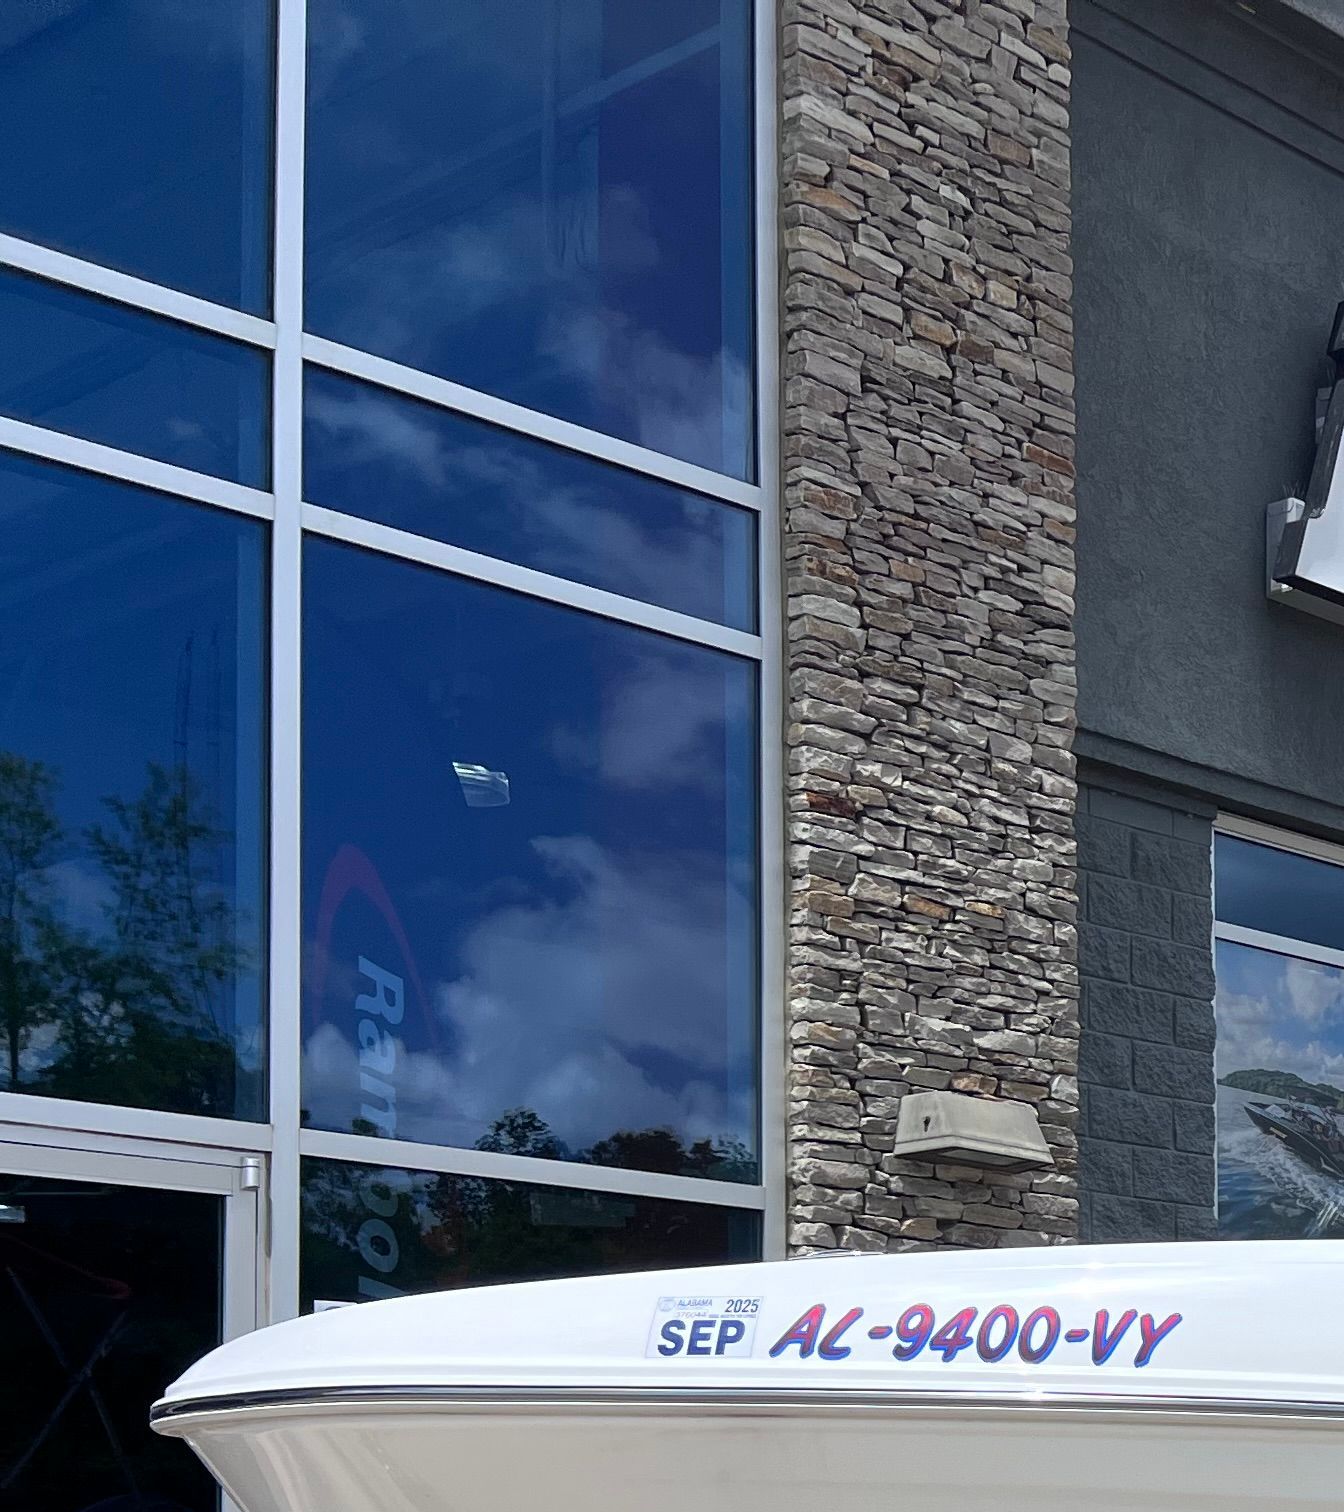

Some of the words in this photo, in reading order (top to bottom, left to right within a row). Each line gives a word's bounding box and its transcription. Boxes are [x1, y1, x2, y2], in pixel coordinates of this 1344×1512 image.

[677, 1299, 713, 1307] ALABAMA
[724, 1298, 760, 1313] 2025
[657, 1319, 746, 1357] SEP
[769, 1303, 1182, 1368] AL-9400-VY
